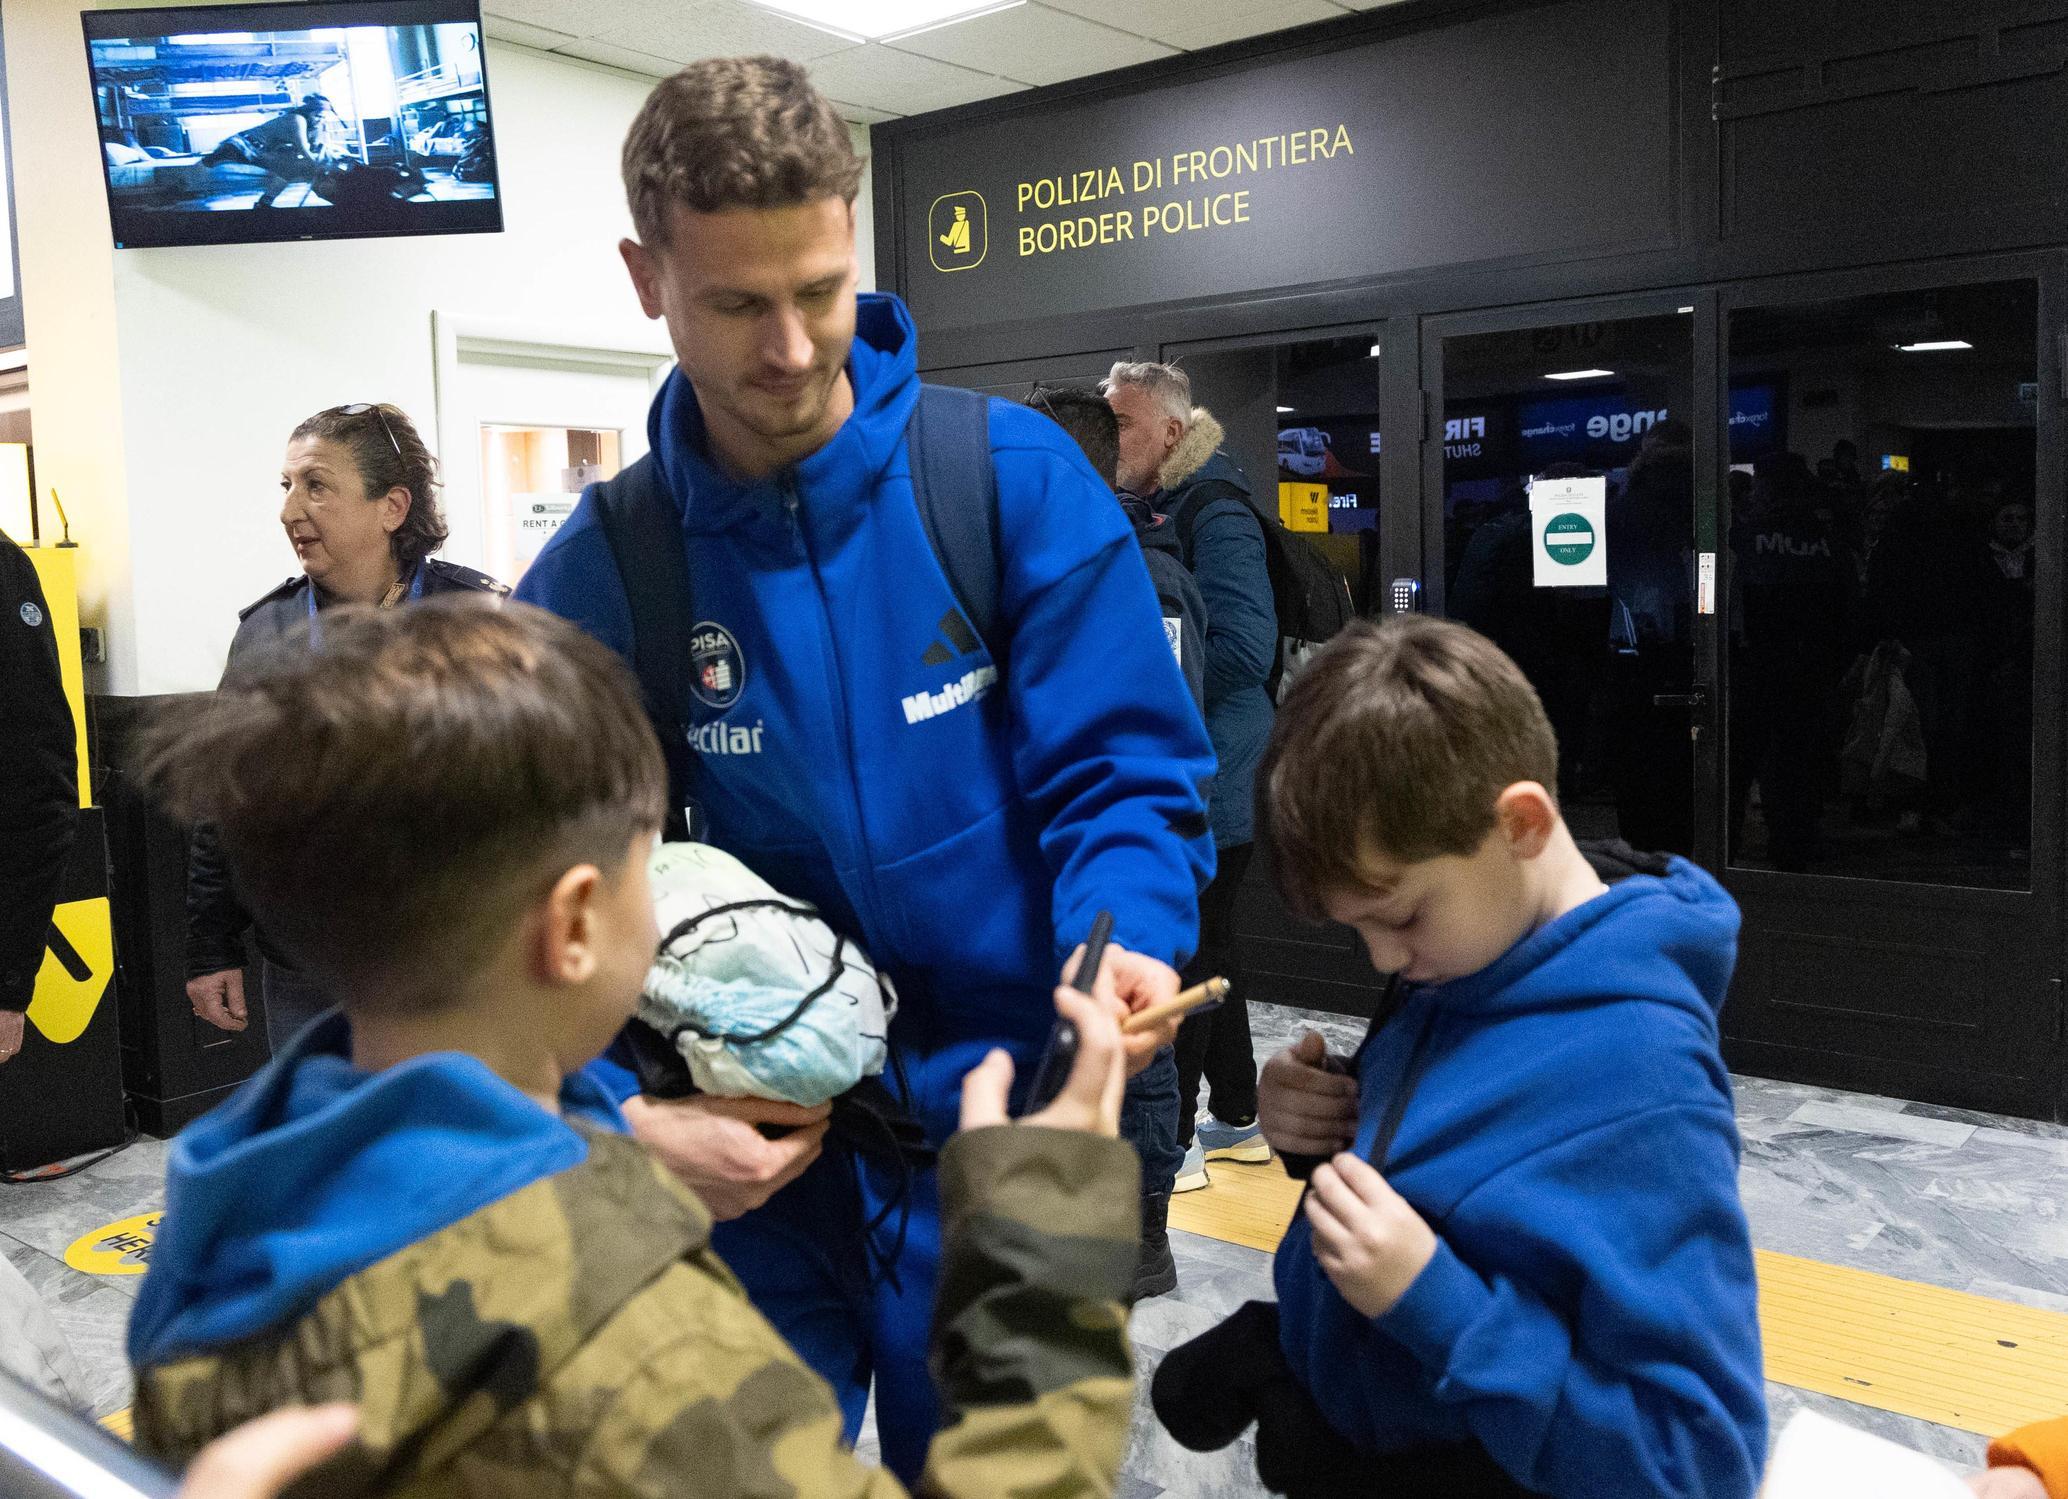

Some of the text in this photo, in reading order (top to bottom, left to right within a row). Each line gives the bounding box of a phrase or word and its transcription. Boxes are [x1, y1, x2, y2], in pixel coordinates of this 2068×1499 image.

[1017, 123, 1354, 212] POLIZIA DI FRONTIERA
[1019, 190, 1250, 257] BORDER POLICE
[522, 519, 548, 528] RENT
[551, 519, 557, 528] A
[100, 1232, 153, 1263] HER
